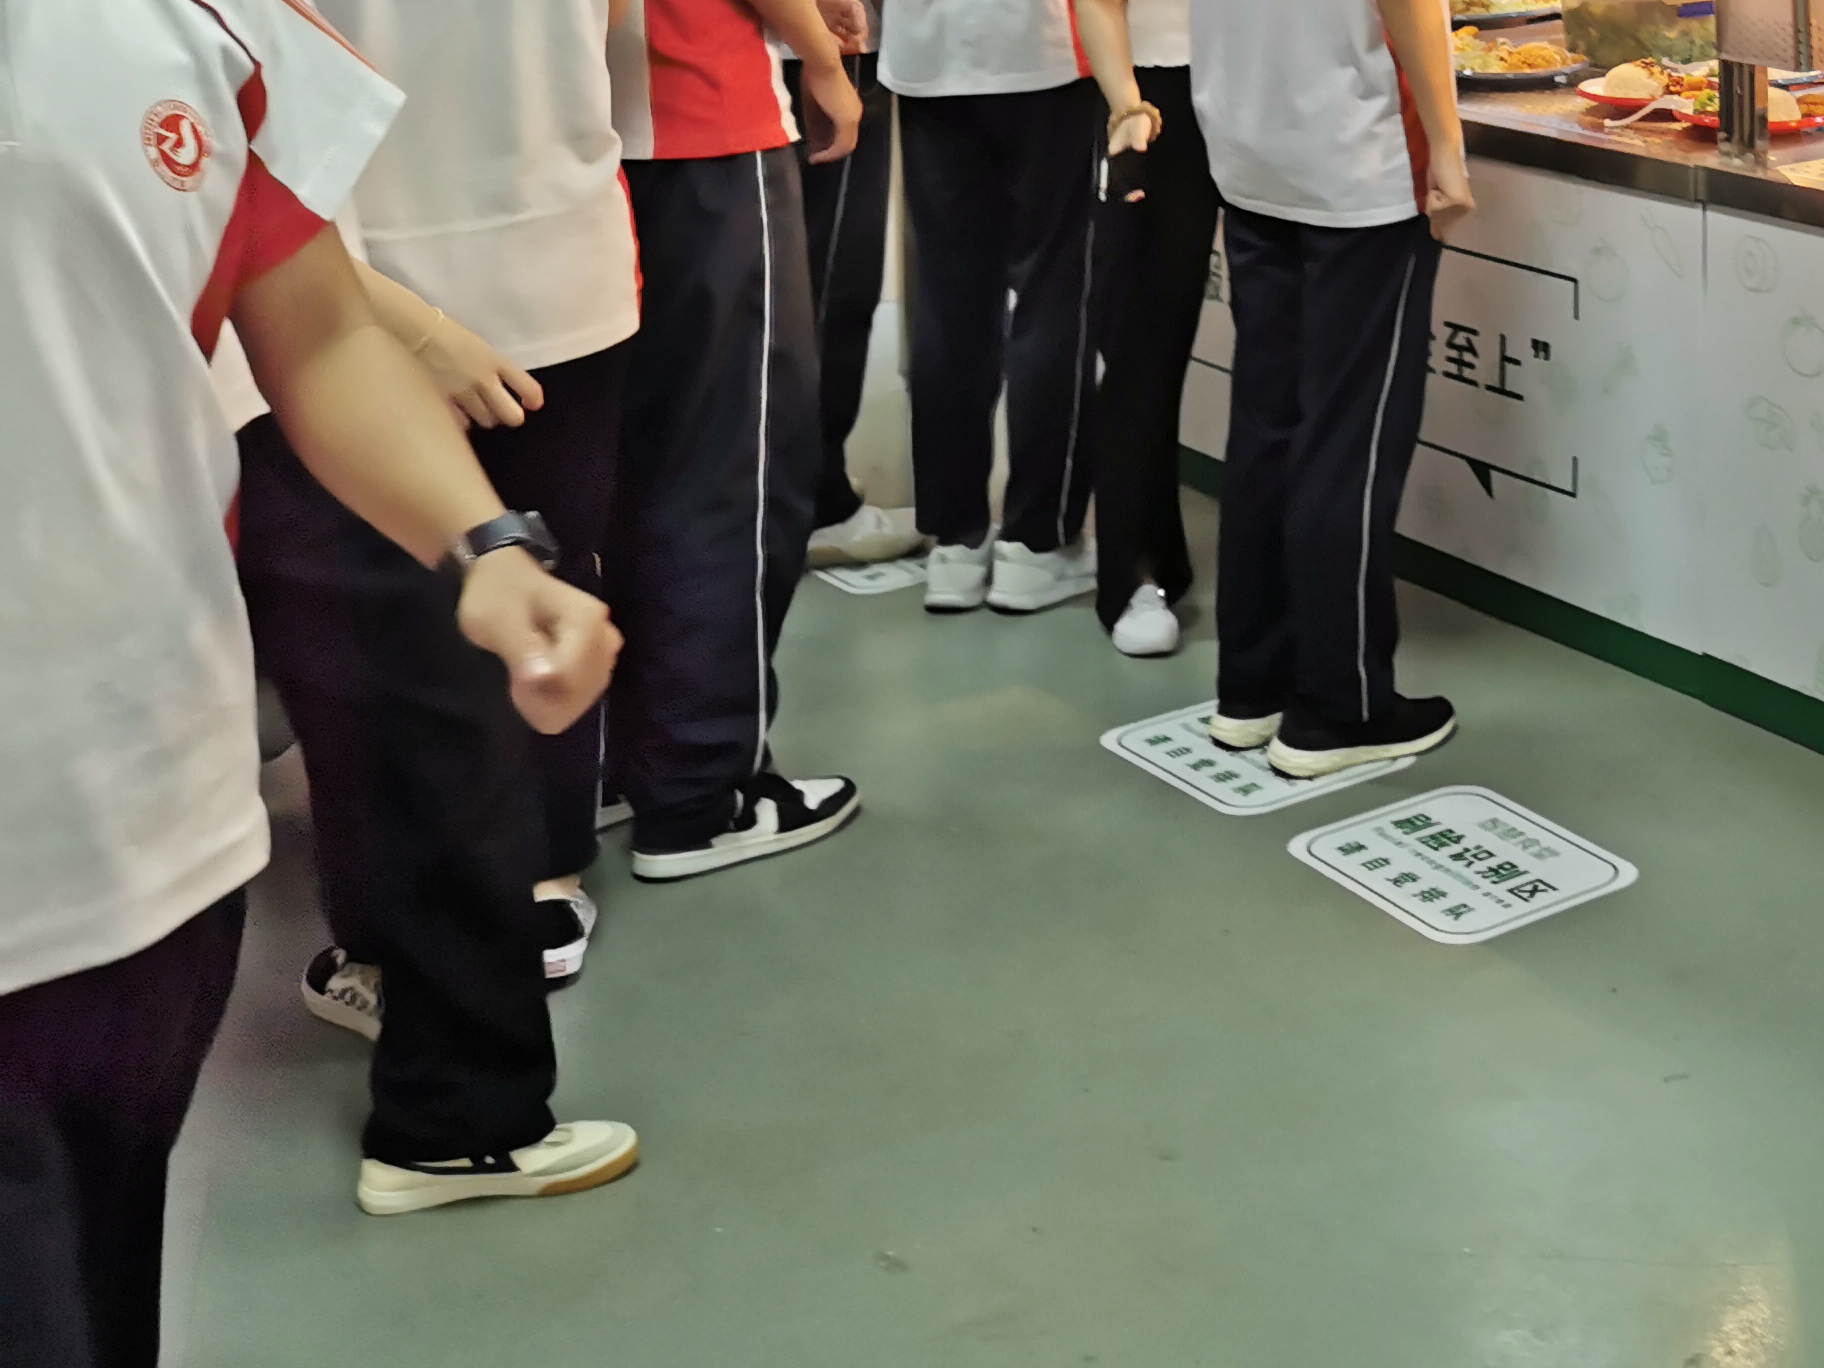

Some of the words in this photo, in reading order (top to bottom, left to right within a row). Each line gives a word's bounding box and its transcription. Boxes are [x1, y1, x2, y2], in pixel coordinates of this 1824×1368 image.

[1336, 839, 1477, 921] 请自觉排队
